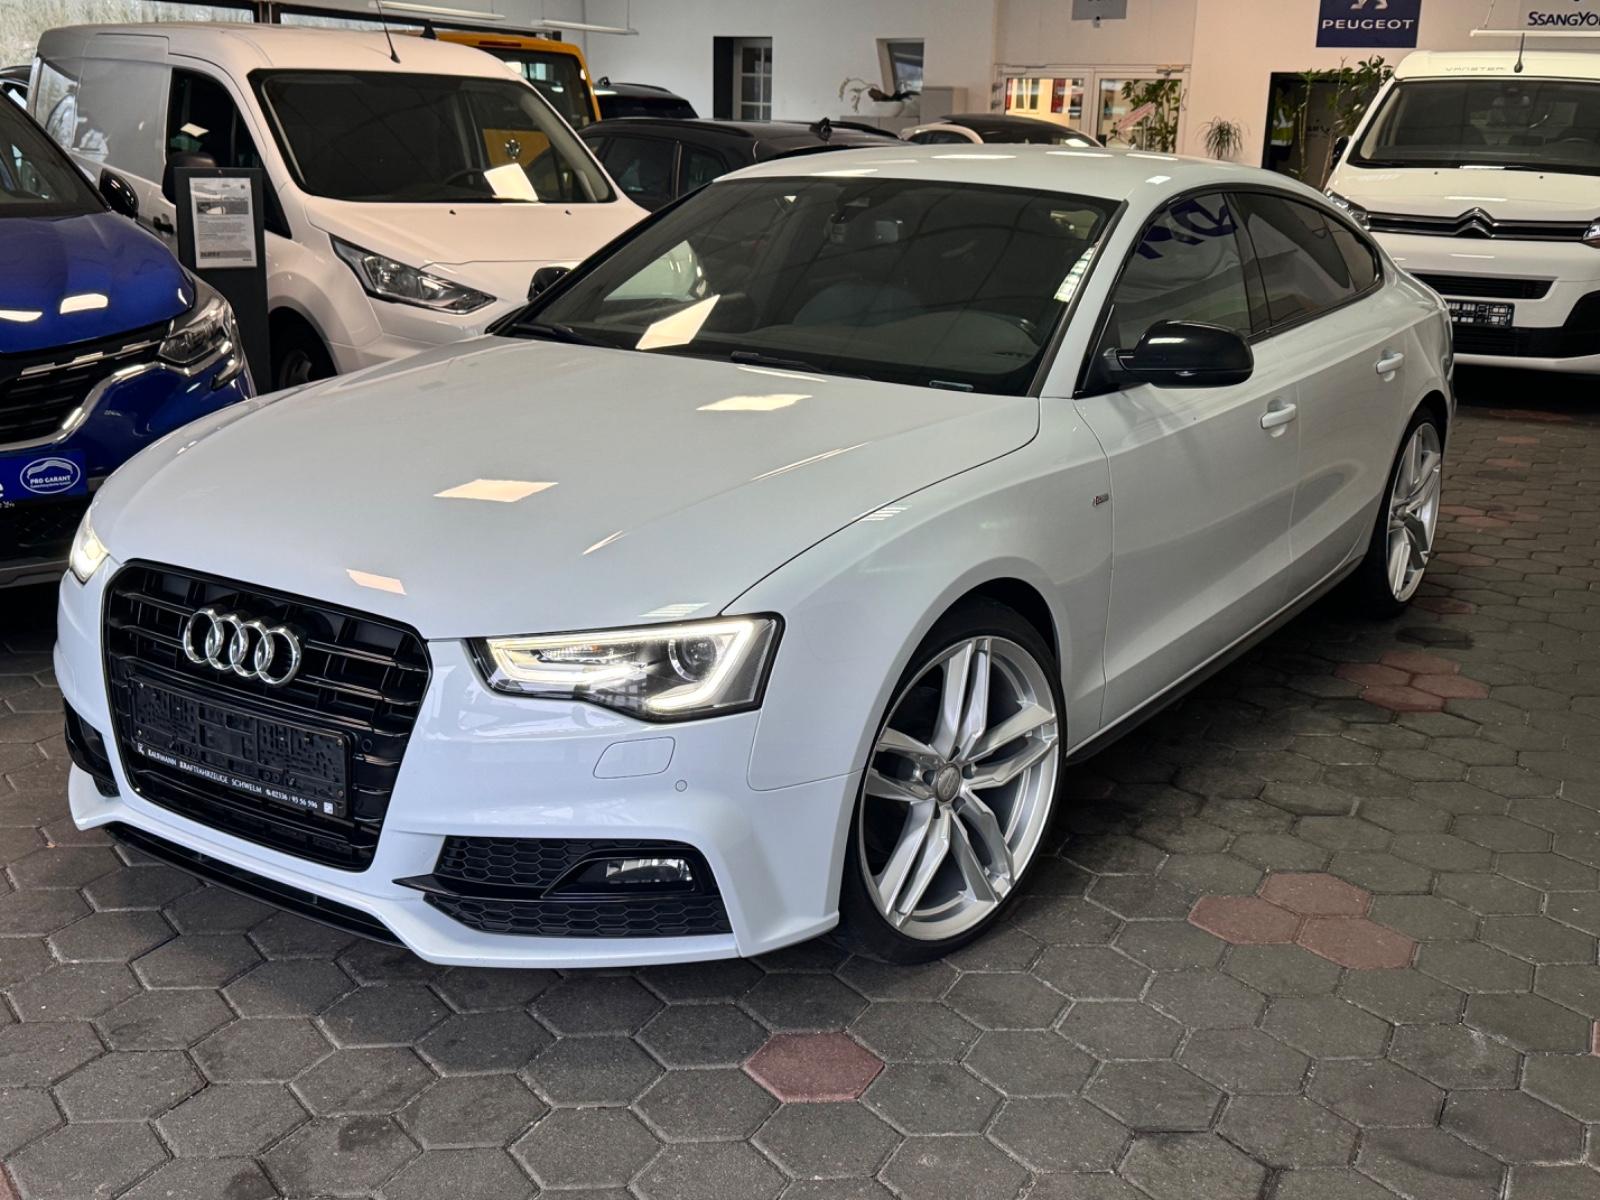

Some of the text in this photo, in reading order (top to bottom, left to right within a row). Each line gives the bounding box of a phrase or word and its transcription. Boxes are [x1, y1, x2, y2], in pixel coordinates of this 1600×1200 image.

[1321, 19, 1414, 30] PEUGEOT
[1527, 11, 1600, 26] SSANGYO
[30, 475, 71, 485] PRO GARANT
[147, 748, 177, 766] KAUFMANN
[179, 761, 228, 784] KRAFTFAHRZEUGE
[231, 778, 262, 793] SCHWELM
